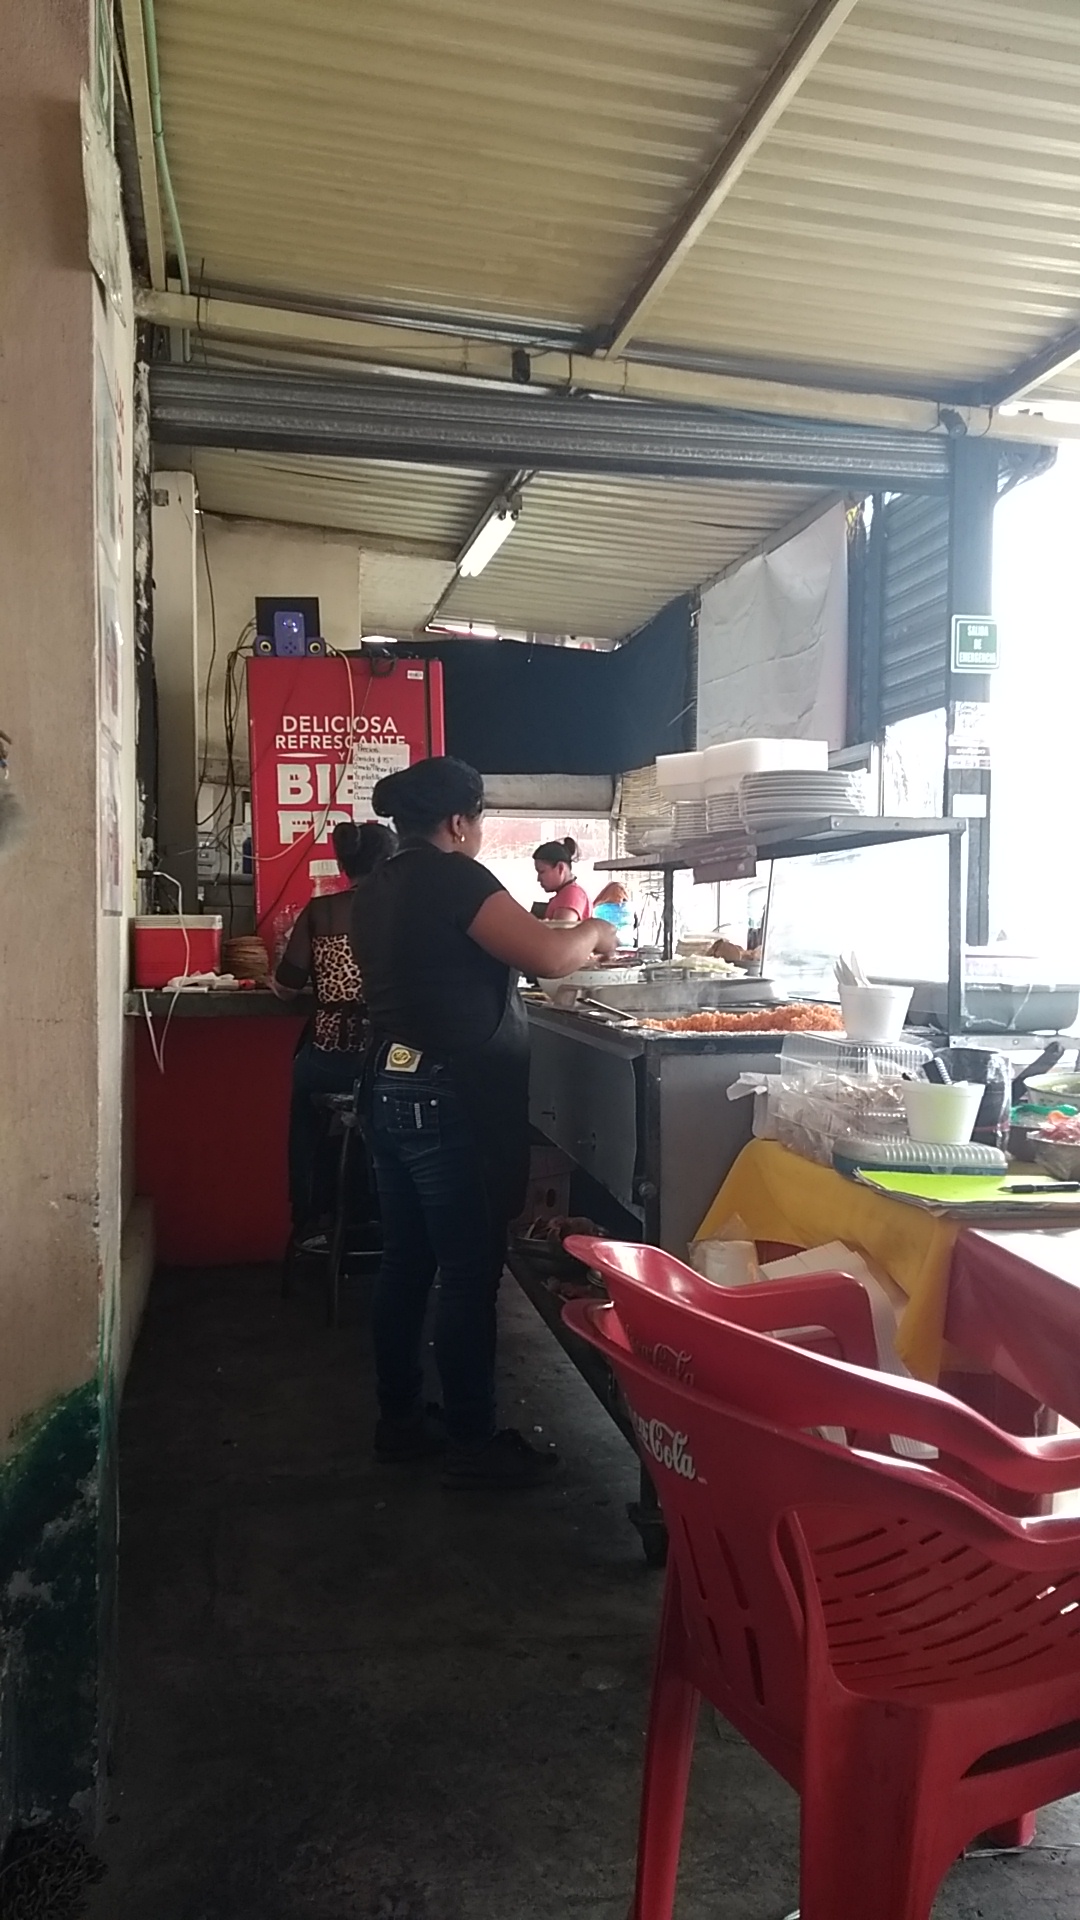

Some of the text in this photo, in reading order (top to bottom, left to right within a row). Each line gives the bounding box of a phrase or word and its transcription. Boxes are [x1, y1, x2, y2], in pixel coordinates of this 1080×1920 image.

[973, 638, 982, 650] DE
[282, 715, 398, 733] DELICIOSA
[277, 763, 354, 805] BIE
